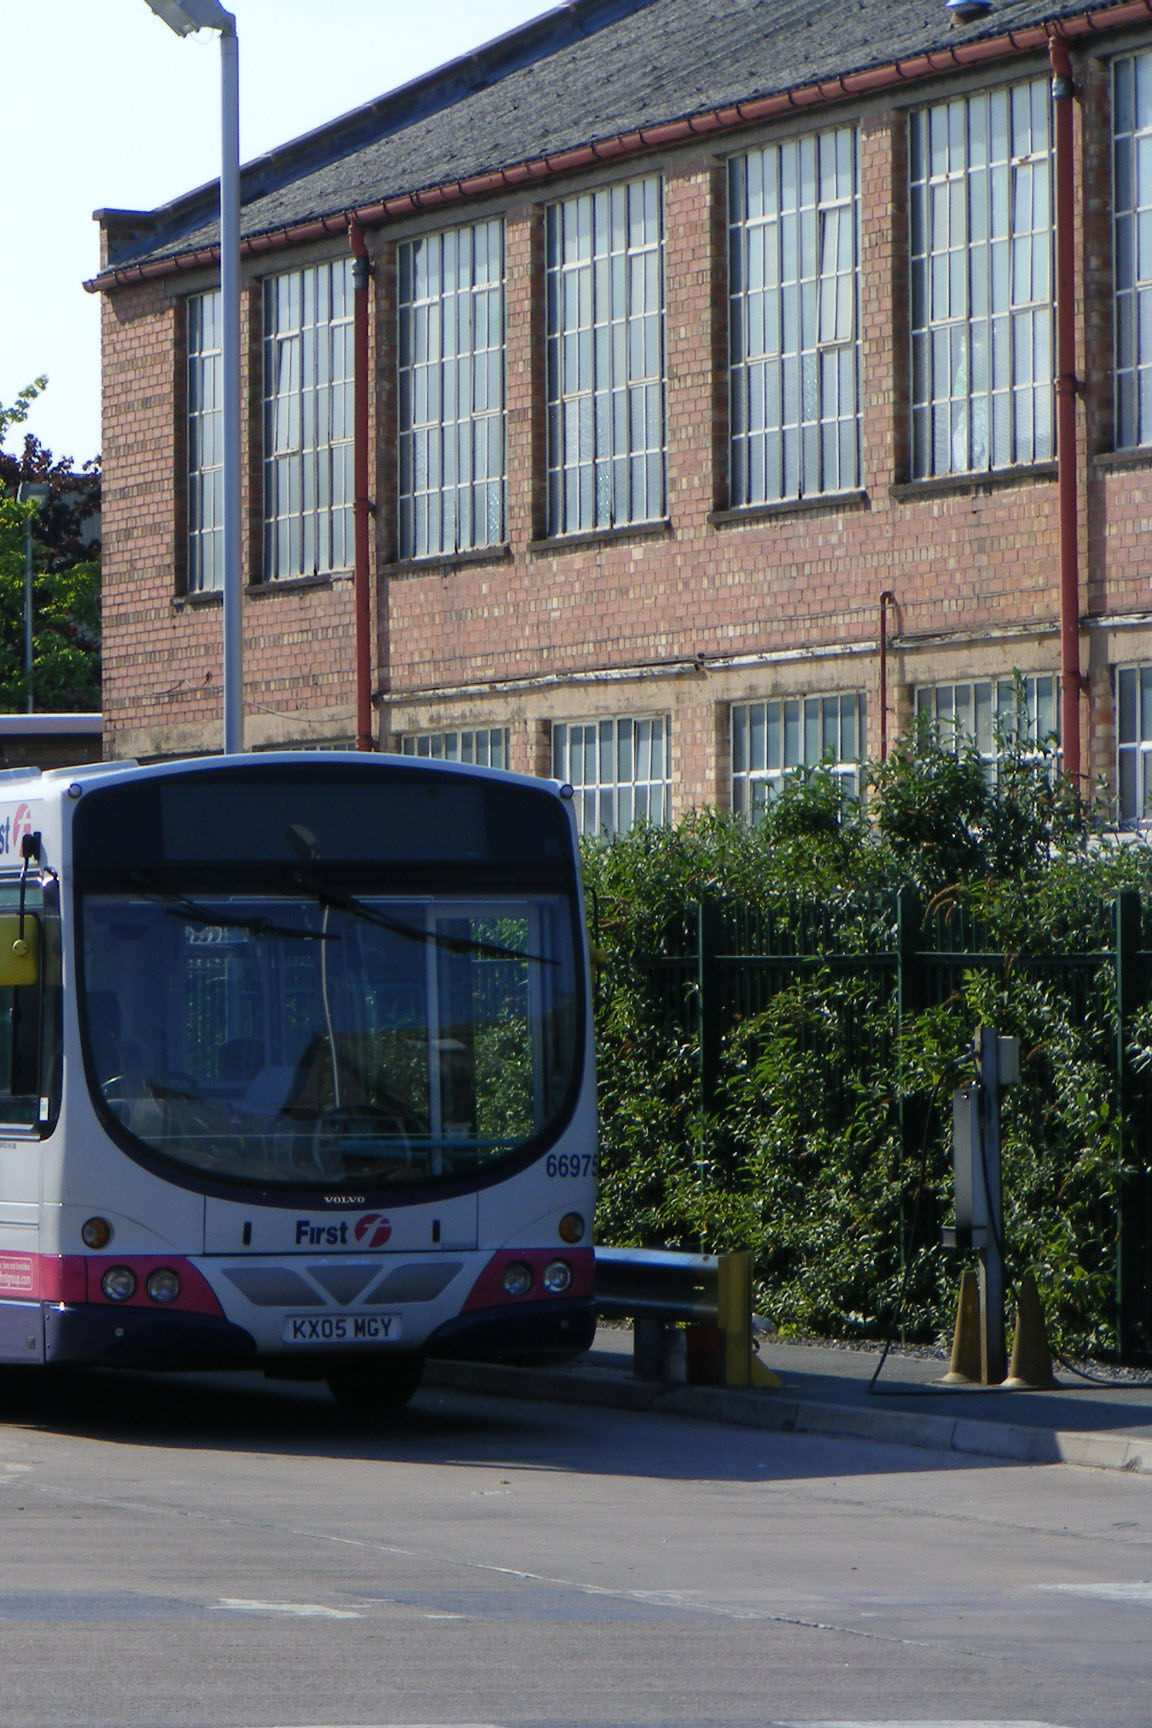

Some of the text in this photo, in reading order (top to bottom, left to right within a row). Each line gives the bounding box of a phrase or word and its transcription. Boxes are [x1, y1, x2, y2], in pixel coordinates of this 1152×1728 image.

[324, 1196, 365, 1204] VOLVO
[295, 1220, 347, 1245] First
[293, 1318, 392, 1338] KX05 MGY
